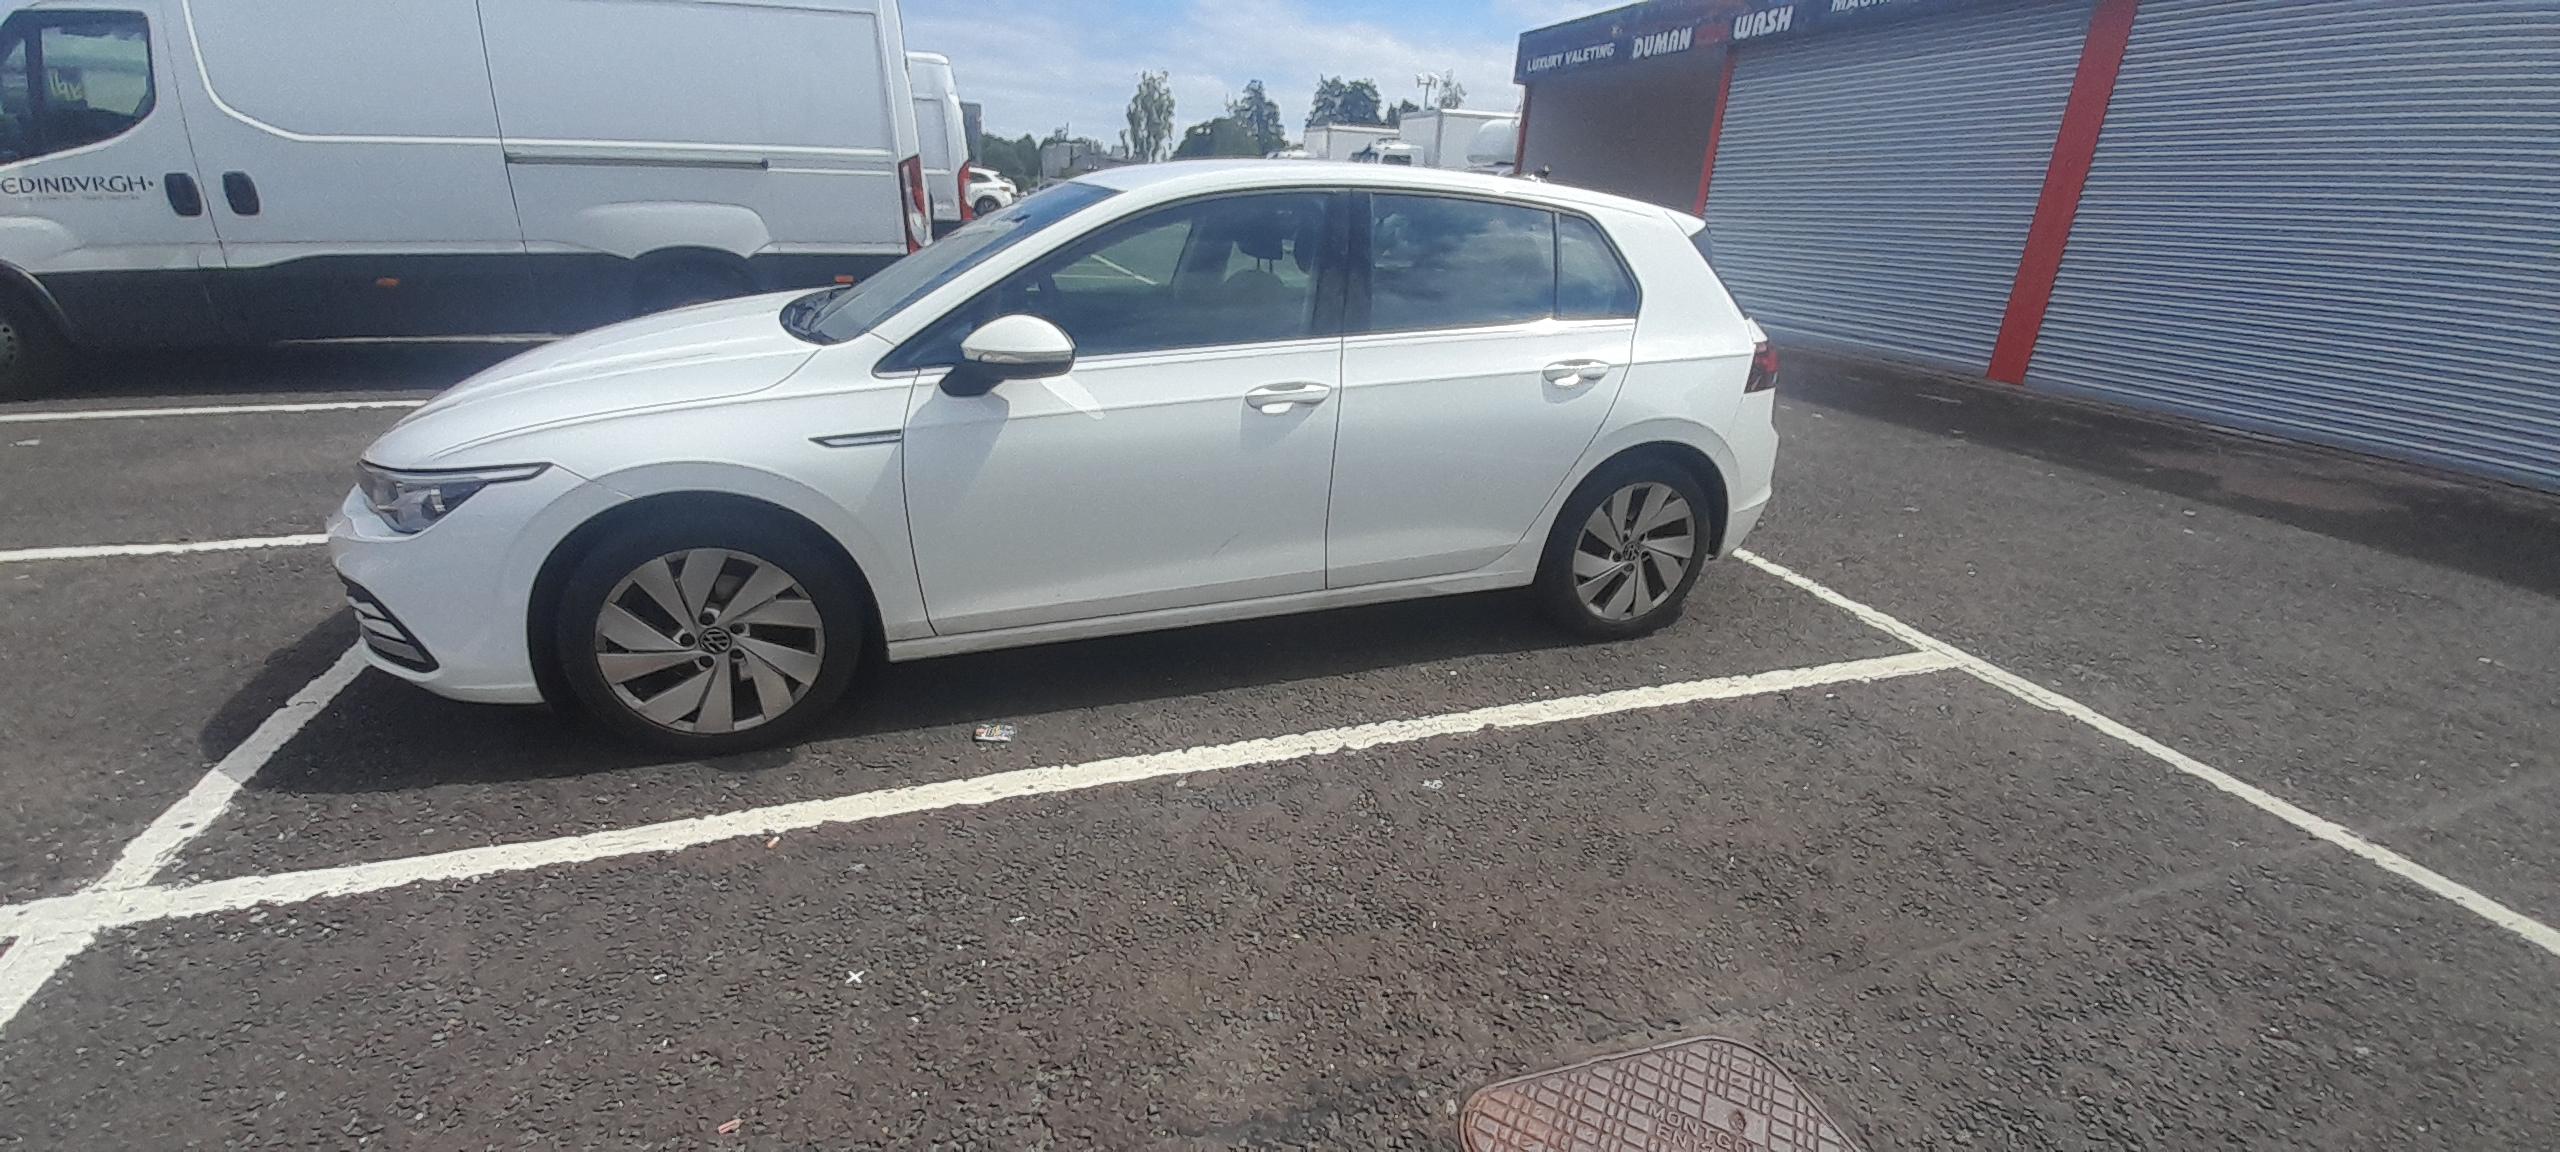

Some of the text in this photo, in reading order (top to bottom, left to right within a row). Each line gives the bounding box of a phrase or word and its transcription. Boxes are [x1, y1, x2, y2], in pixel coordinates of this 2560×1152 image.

[1632, 5, 1794, 60] DUMAN WASH
[1527, 42, 1616, 72] LUXURY VALETING
